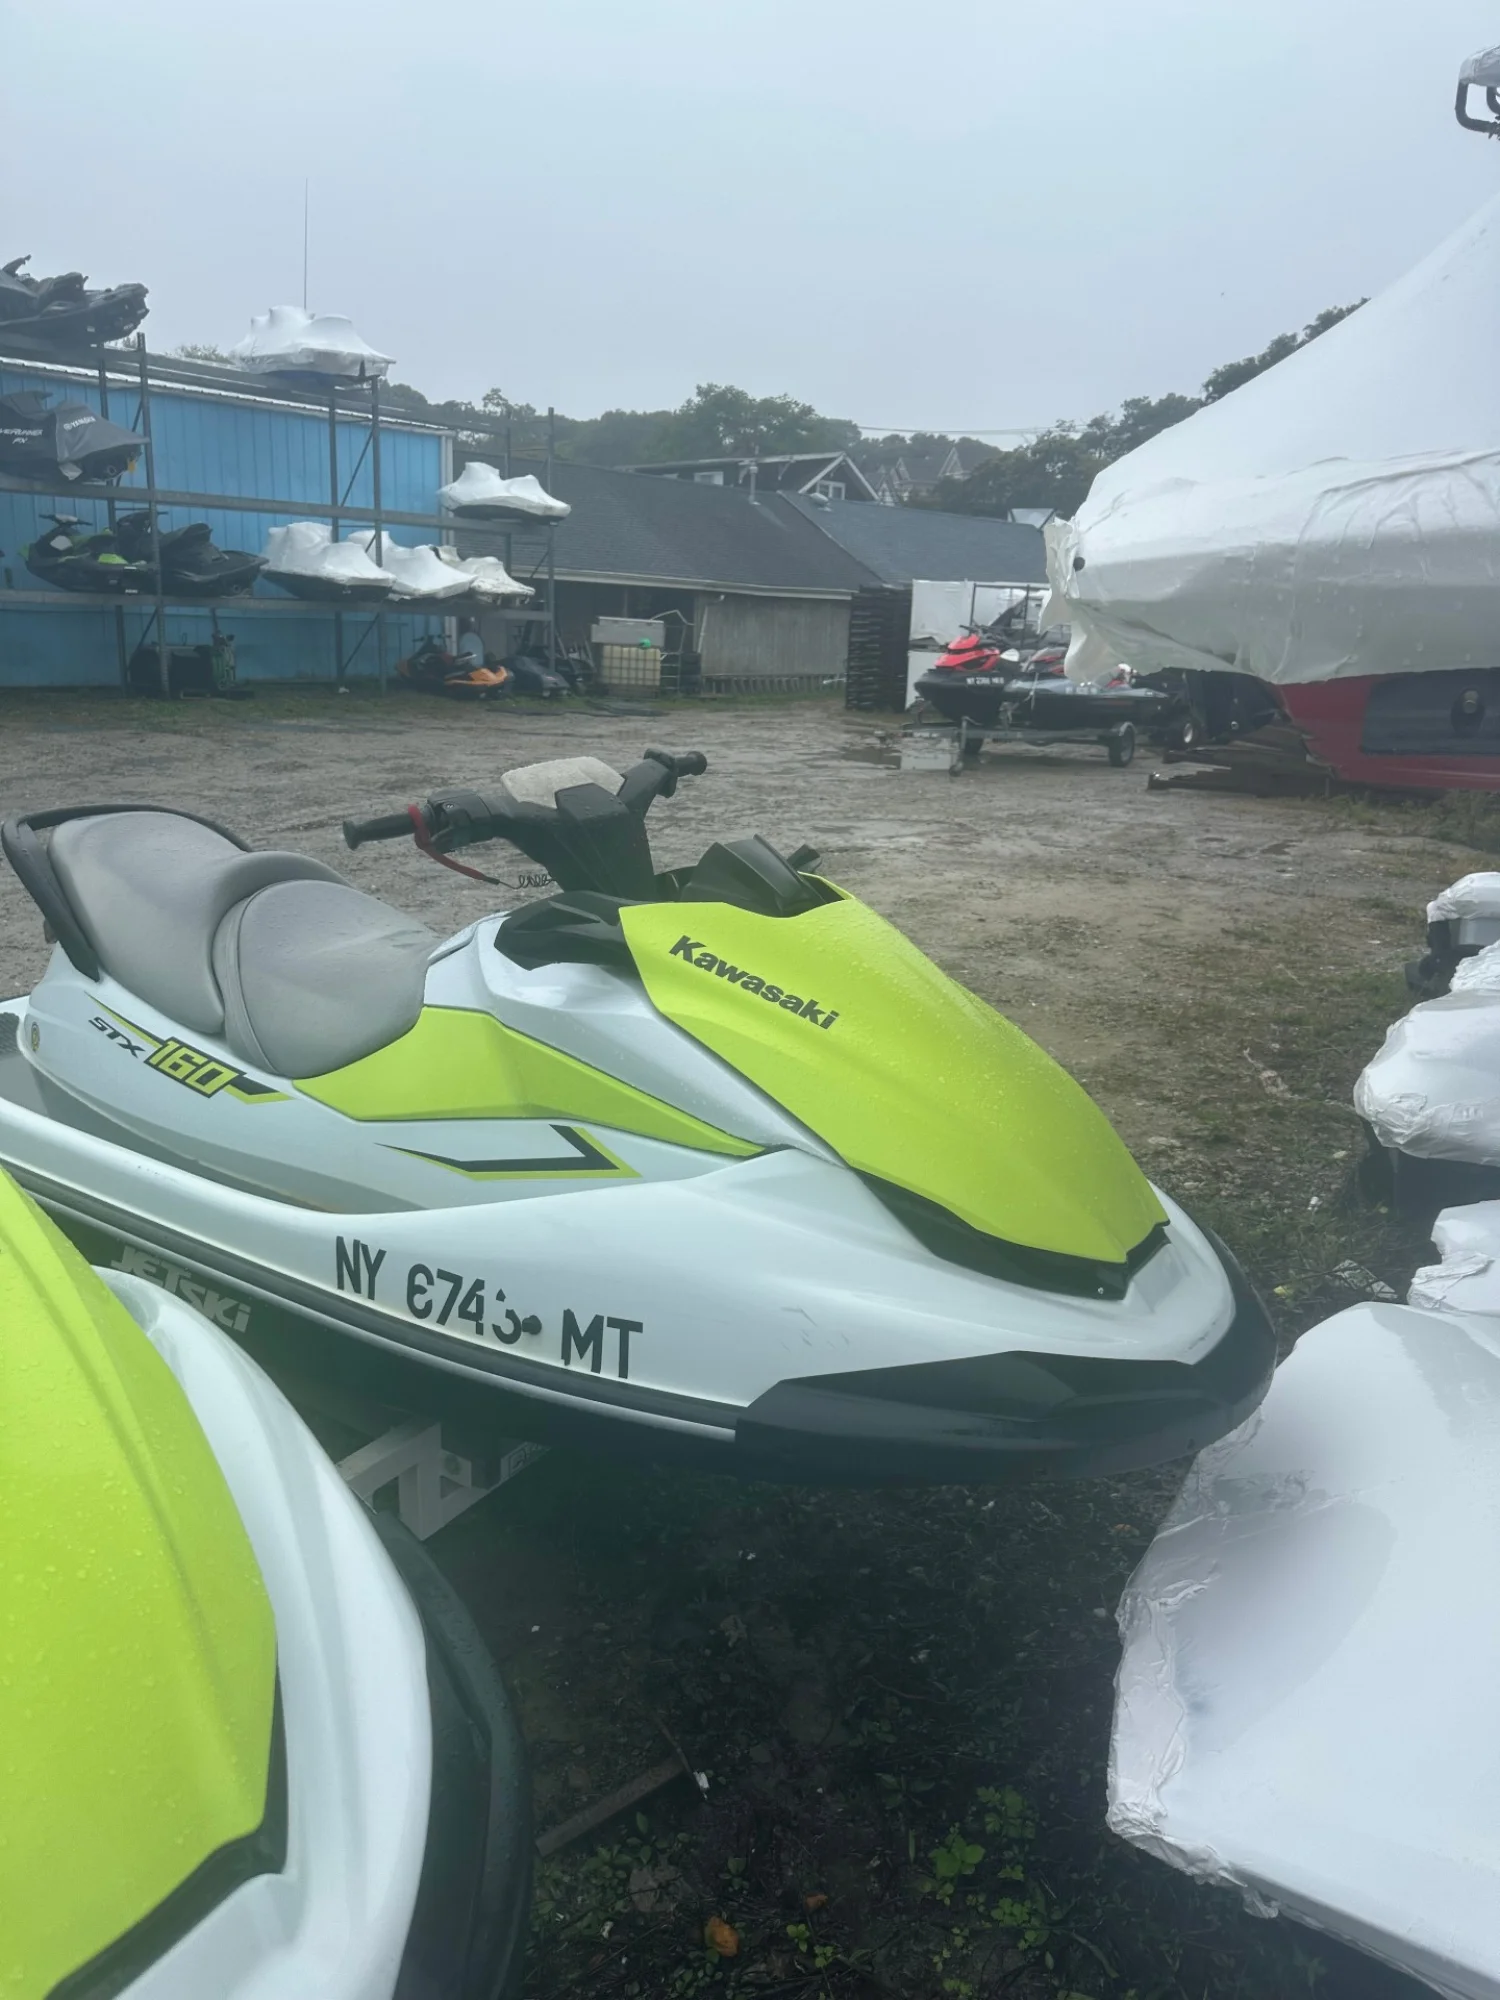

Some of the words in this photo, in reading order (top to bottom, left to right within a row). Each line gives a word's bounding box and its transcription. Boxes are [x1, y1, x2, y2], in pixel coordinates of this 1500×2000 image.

[669, 935, 839, 1030] Kawasaki
[88, 1016, 145, 1058] STX
[146, 1039, 242, 1097] 160
[336, 1235, 387, 1301] NY
[561, 1308, 644, 1380] MT
